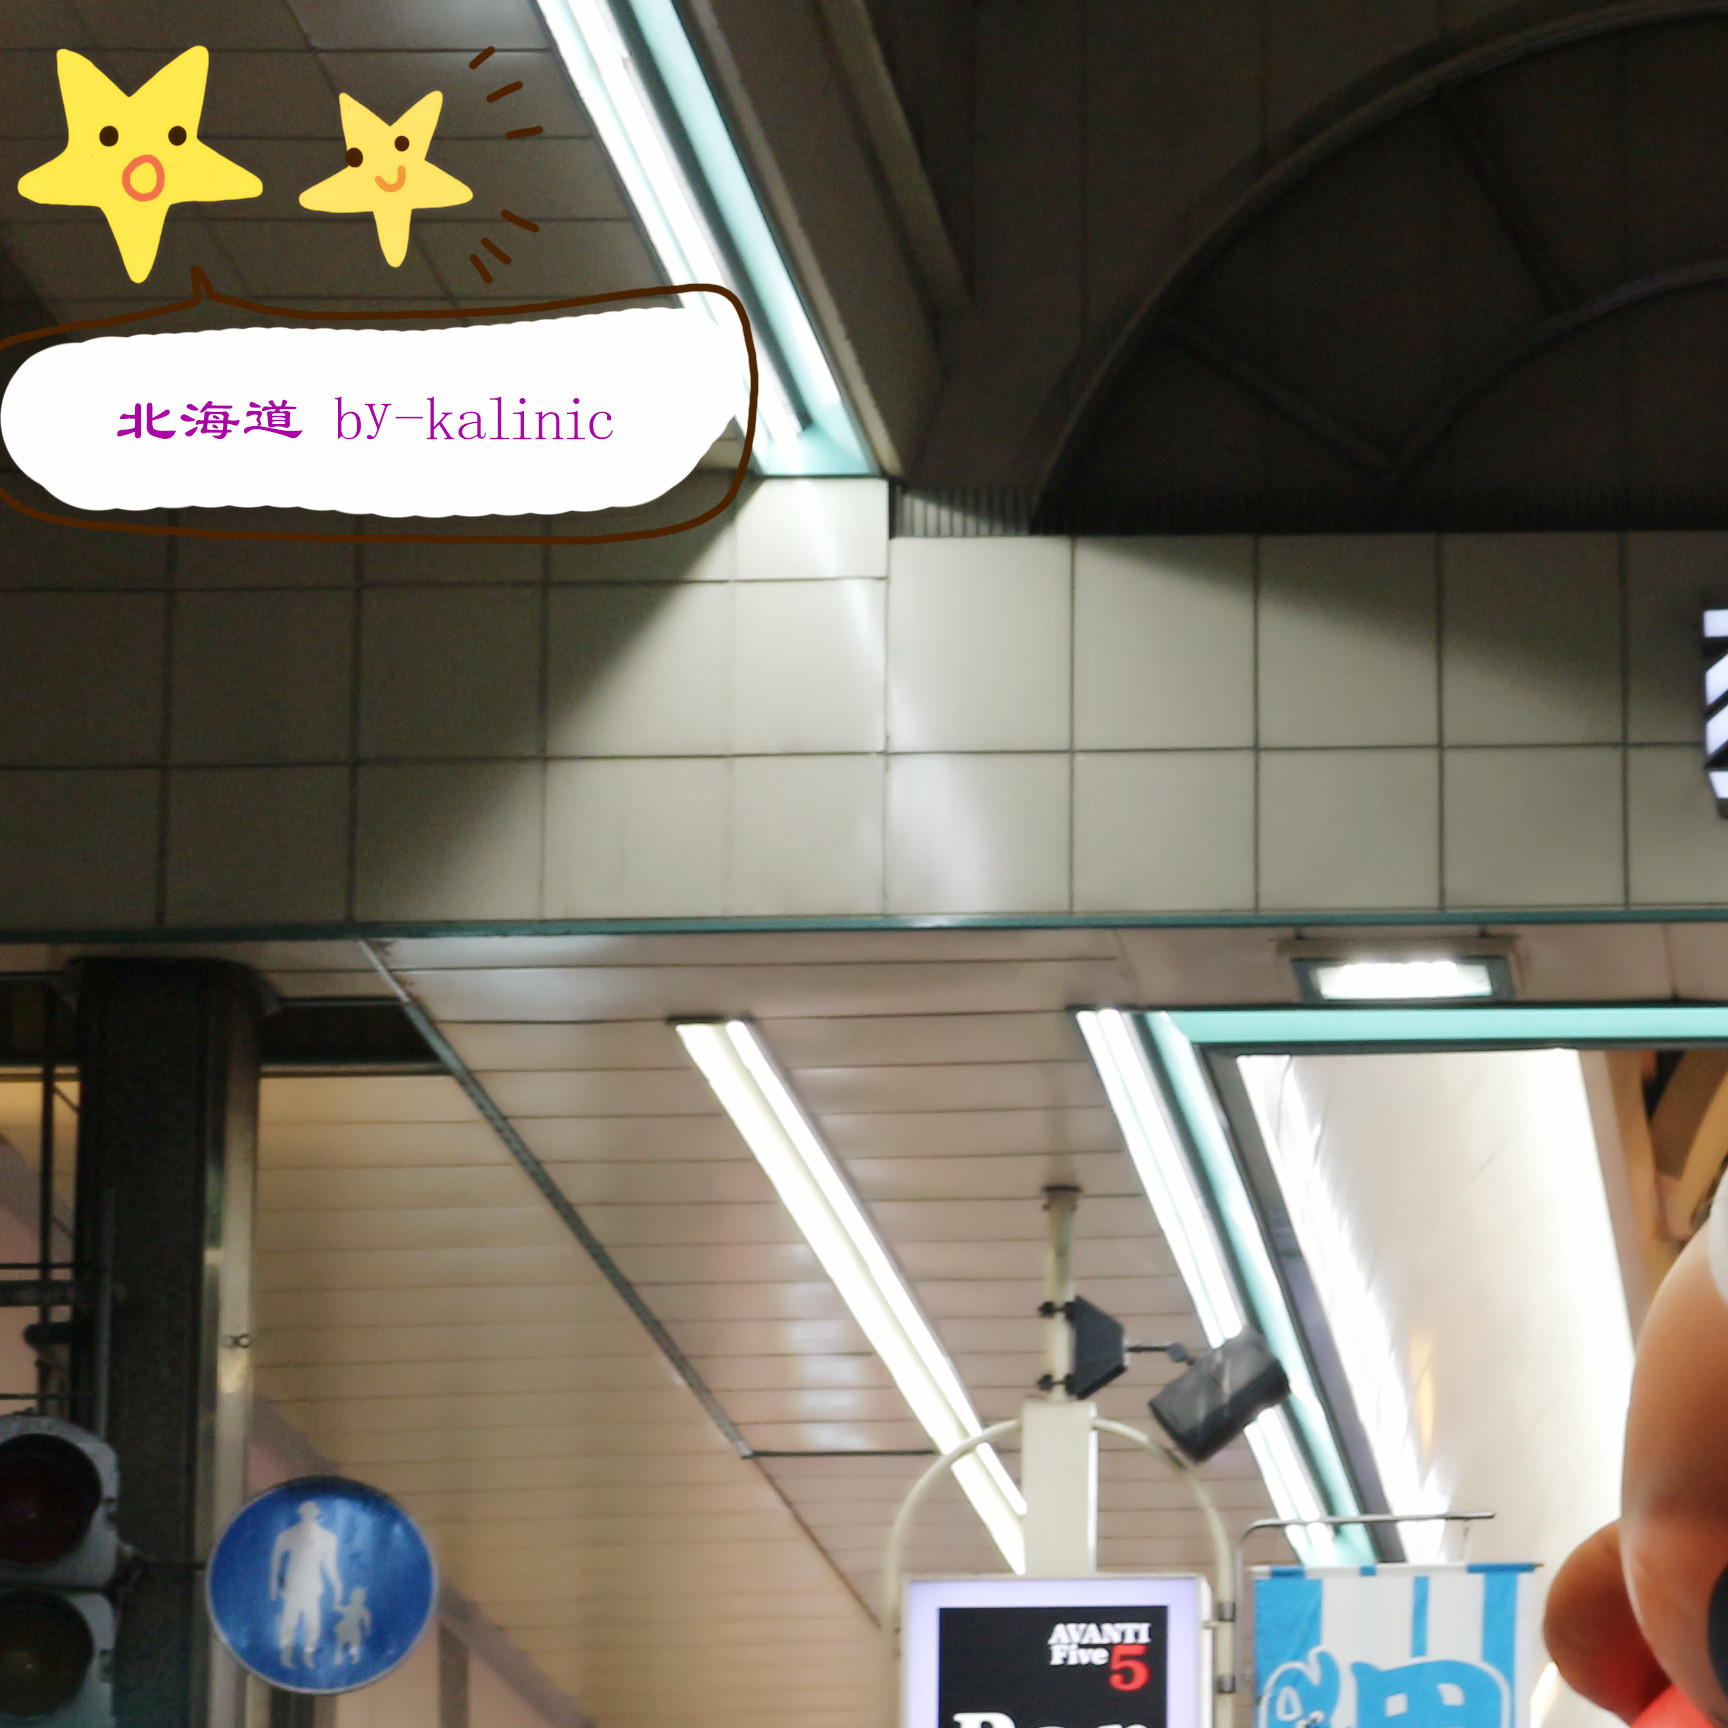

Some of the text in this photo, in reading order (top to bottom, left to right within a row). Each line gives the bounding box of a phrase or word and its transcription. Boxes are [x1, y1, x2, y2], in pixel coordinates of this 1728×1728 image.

[1050, 1623, 1150, 1645] AVANTI
[1050, 1644, 1150, 1690] Five 5
